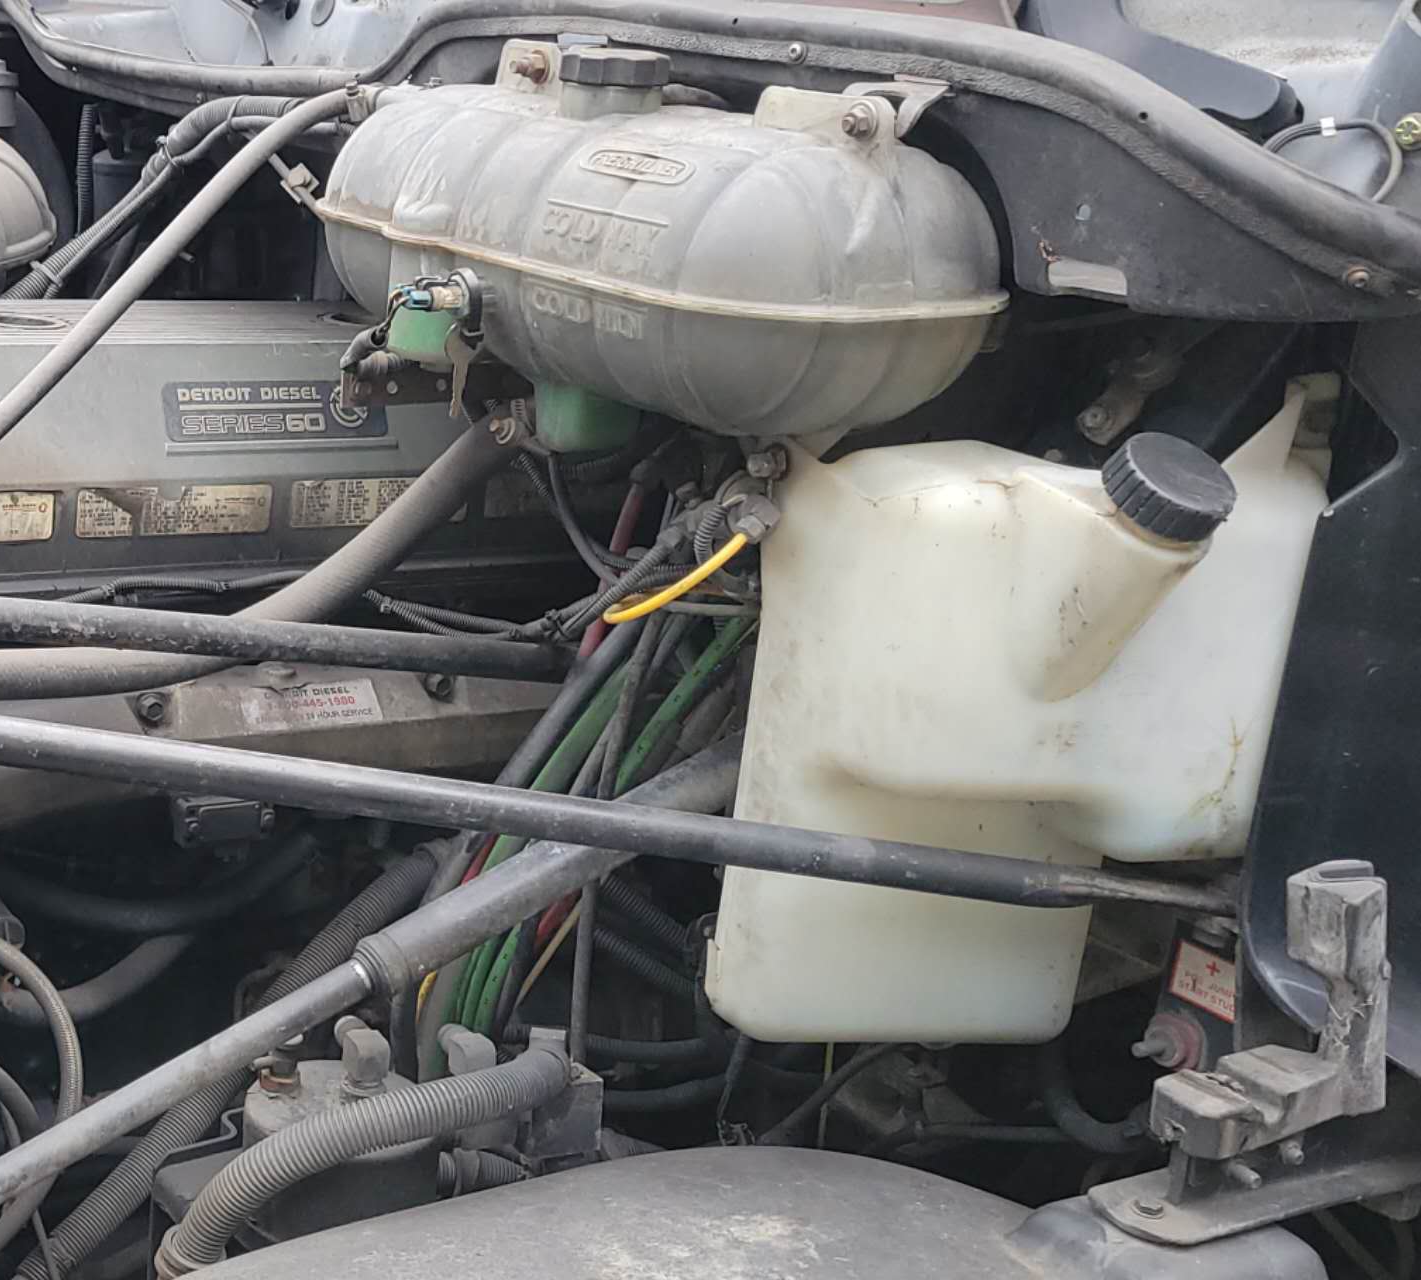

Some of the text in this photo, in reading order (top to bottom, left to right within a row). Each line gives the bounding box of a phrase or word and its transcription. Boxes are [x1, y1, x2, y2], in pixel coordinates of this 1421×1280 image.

[541, 208, 598, 243] COLD
[533, 286, 591, 324] COLD
[177, 386, 322, 401] DETROIT DIESEL
[312, 687, 351, 696] DIESEL
[341, 707, 373, 718] SERVICE
